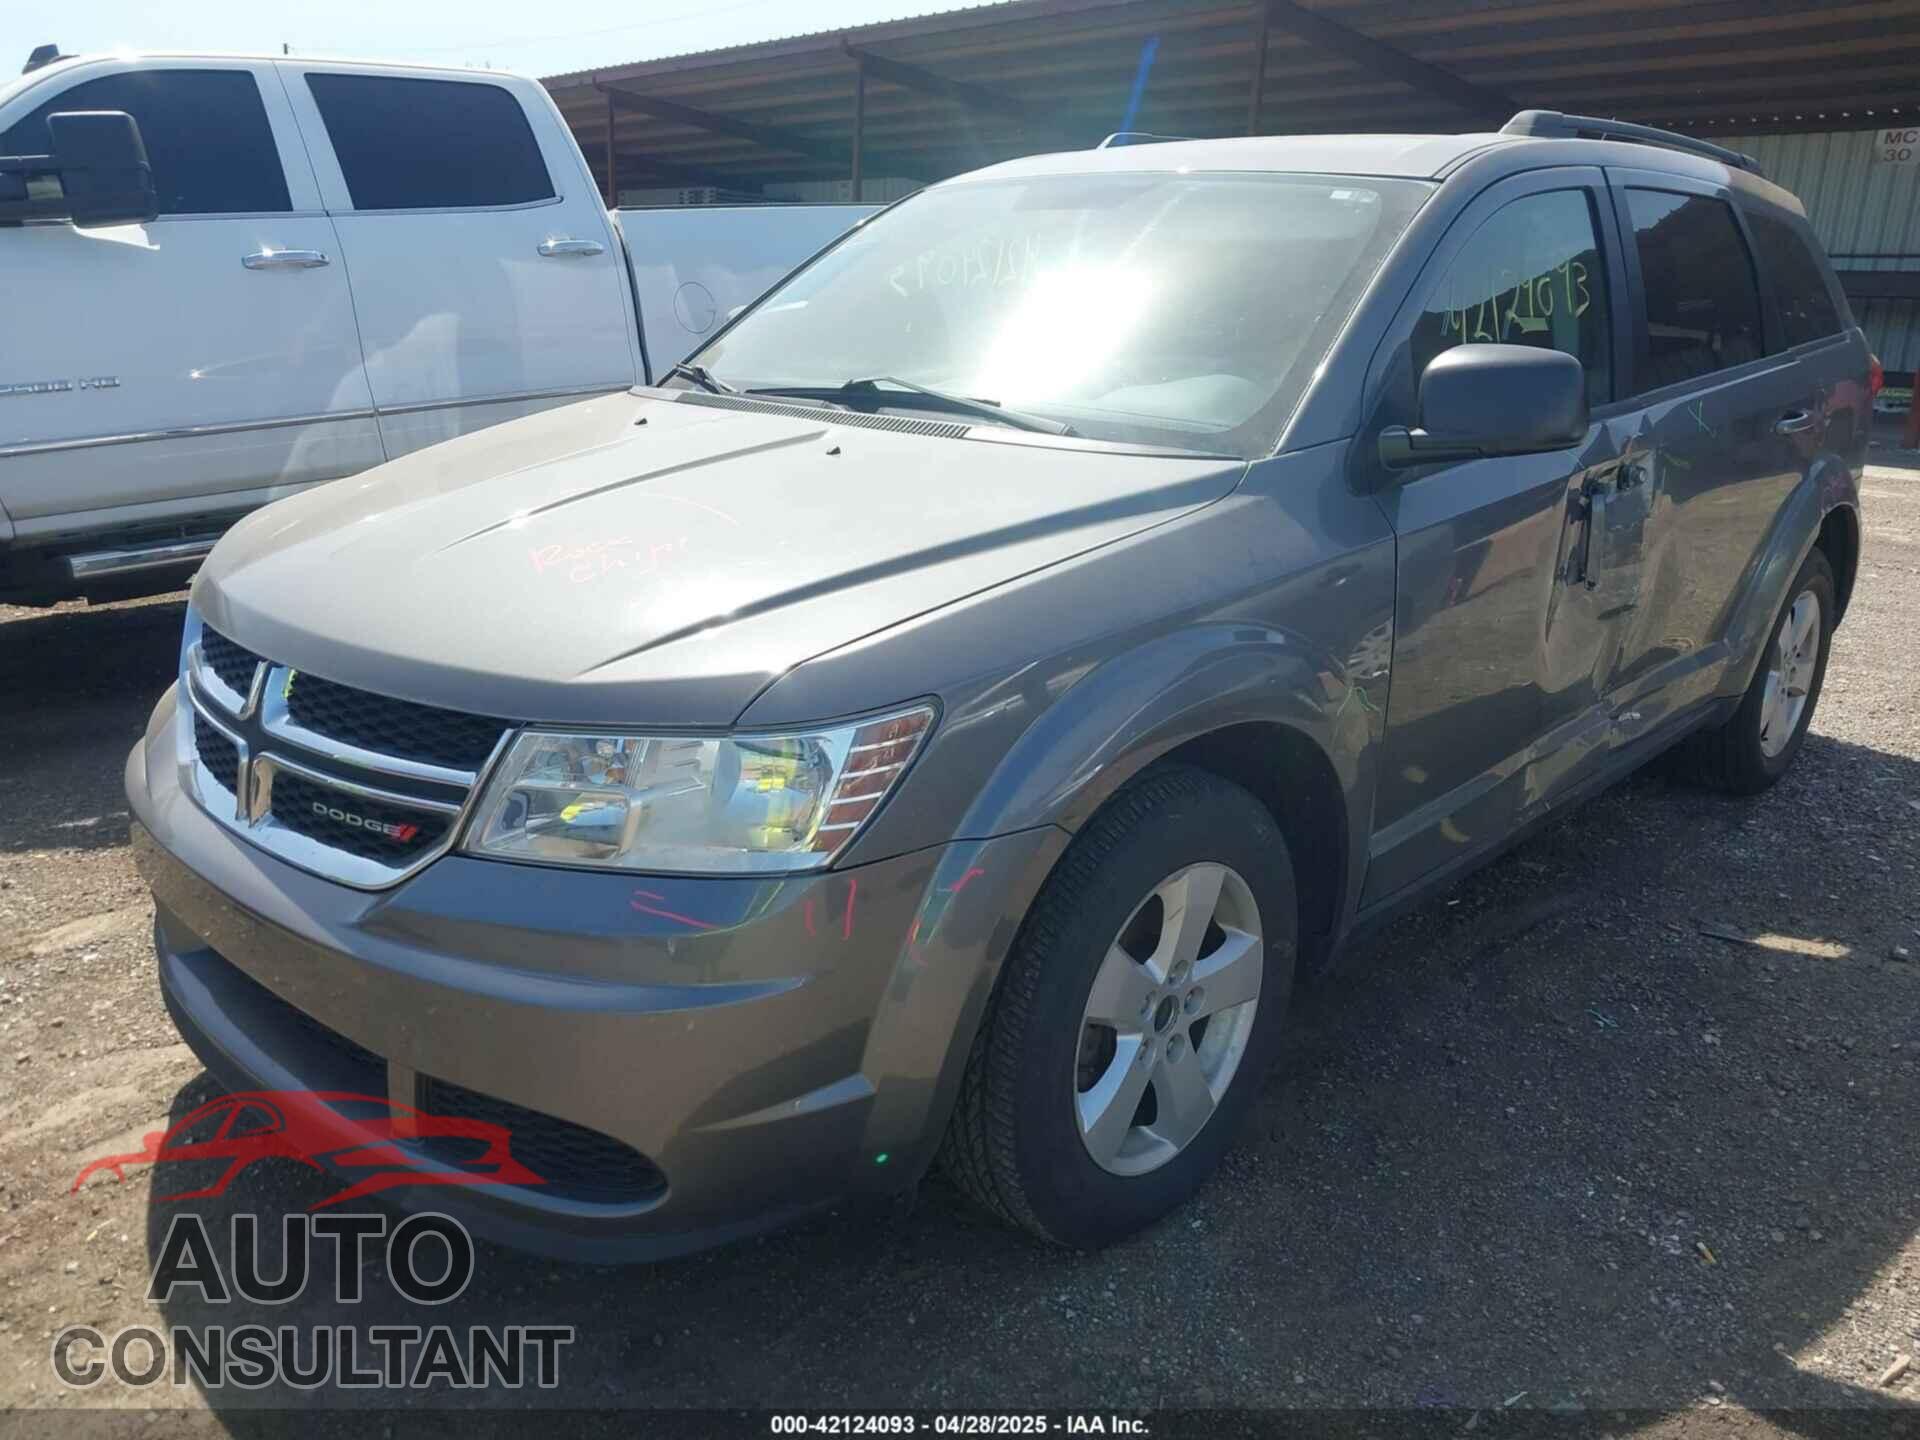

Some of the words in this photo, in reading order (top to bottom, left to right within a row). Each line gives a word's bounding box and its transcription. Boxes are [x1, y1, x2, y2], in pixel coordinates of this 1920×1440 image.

[1884, 130, 1919, 144] MC
[1883, 149, 1912, 161] 30
[312, 801, 401, 839] DODGE
